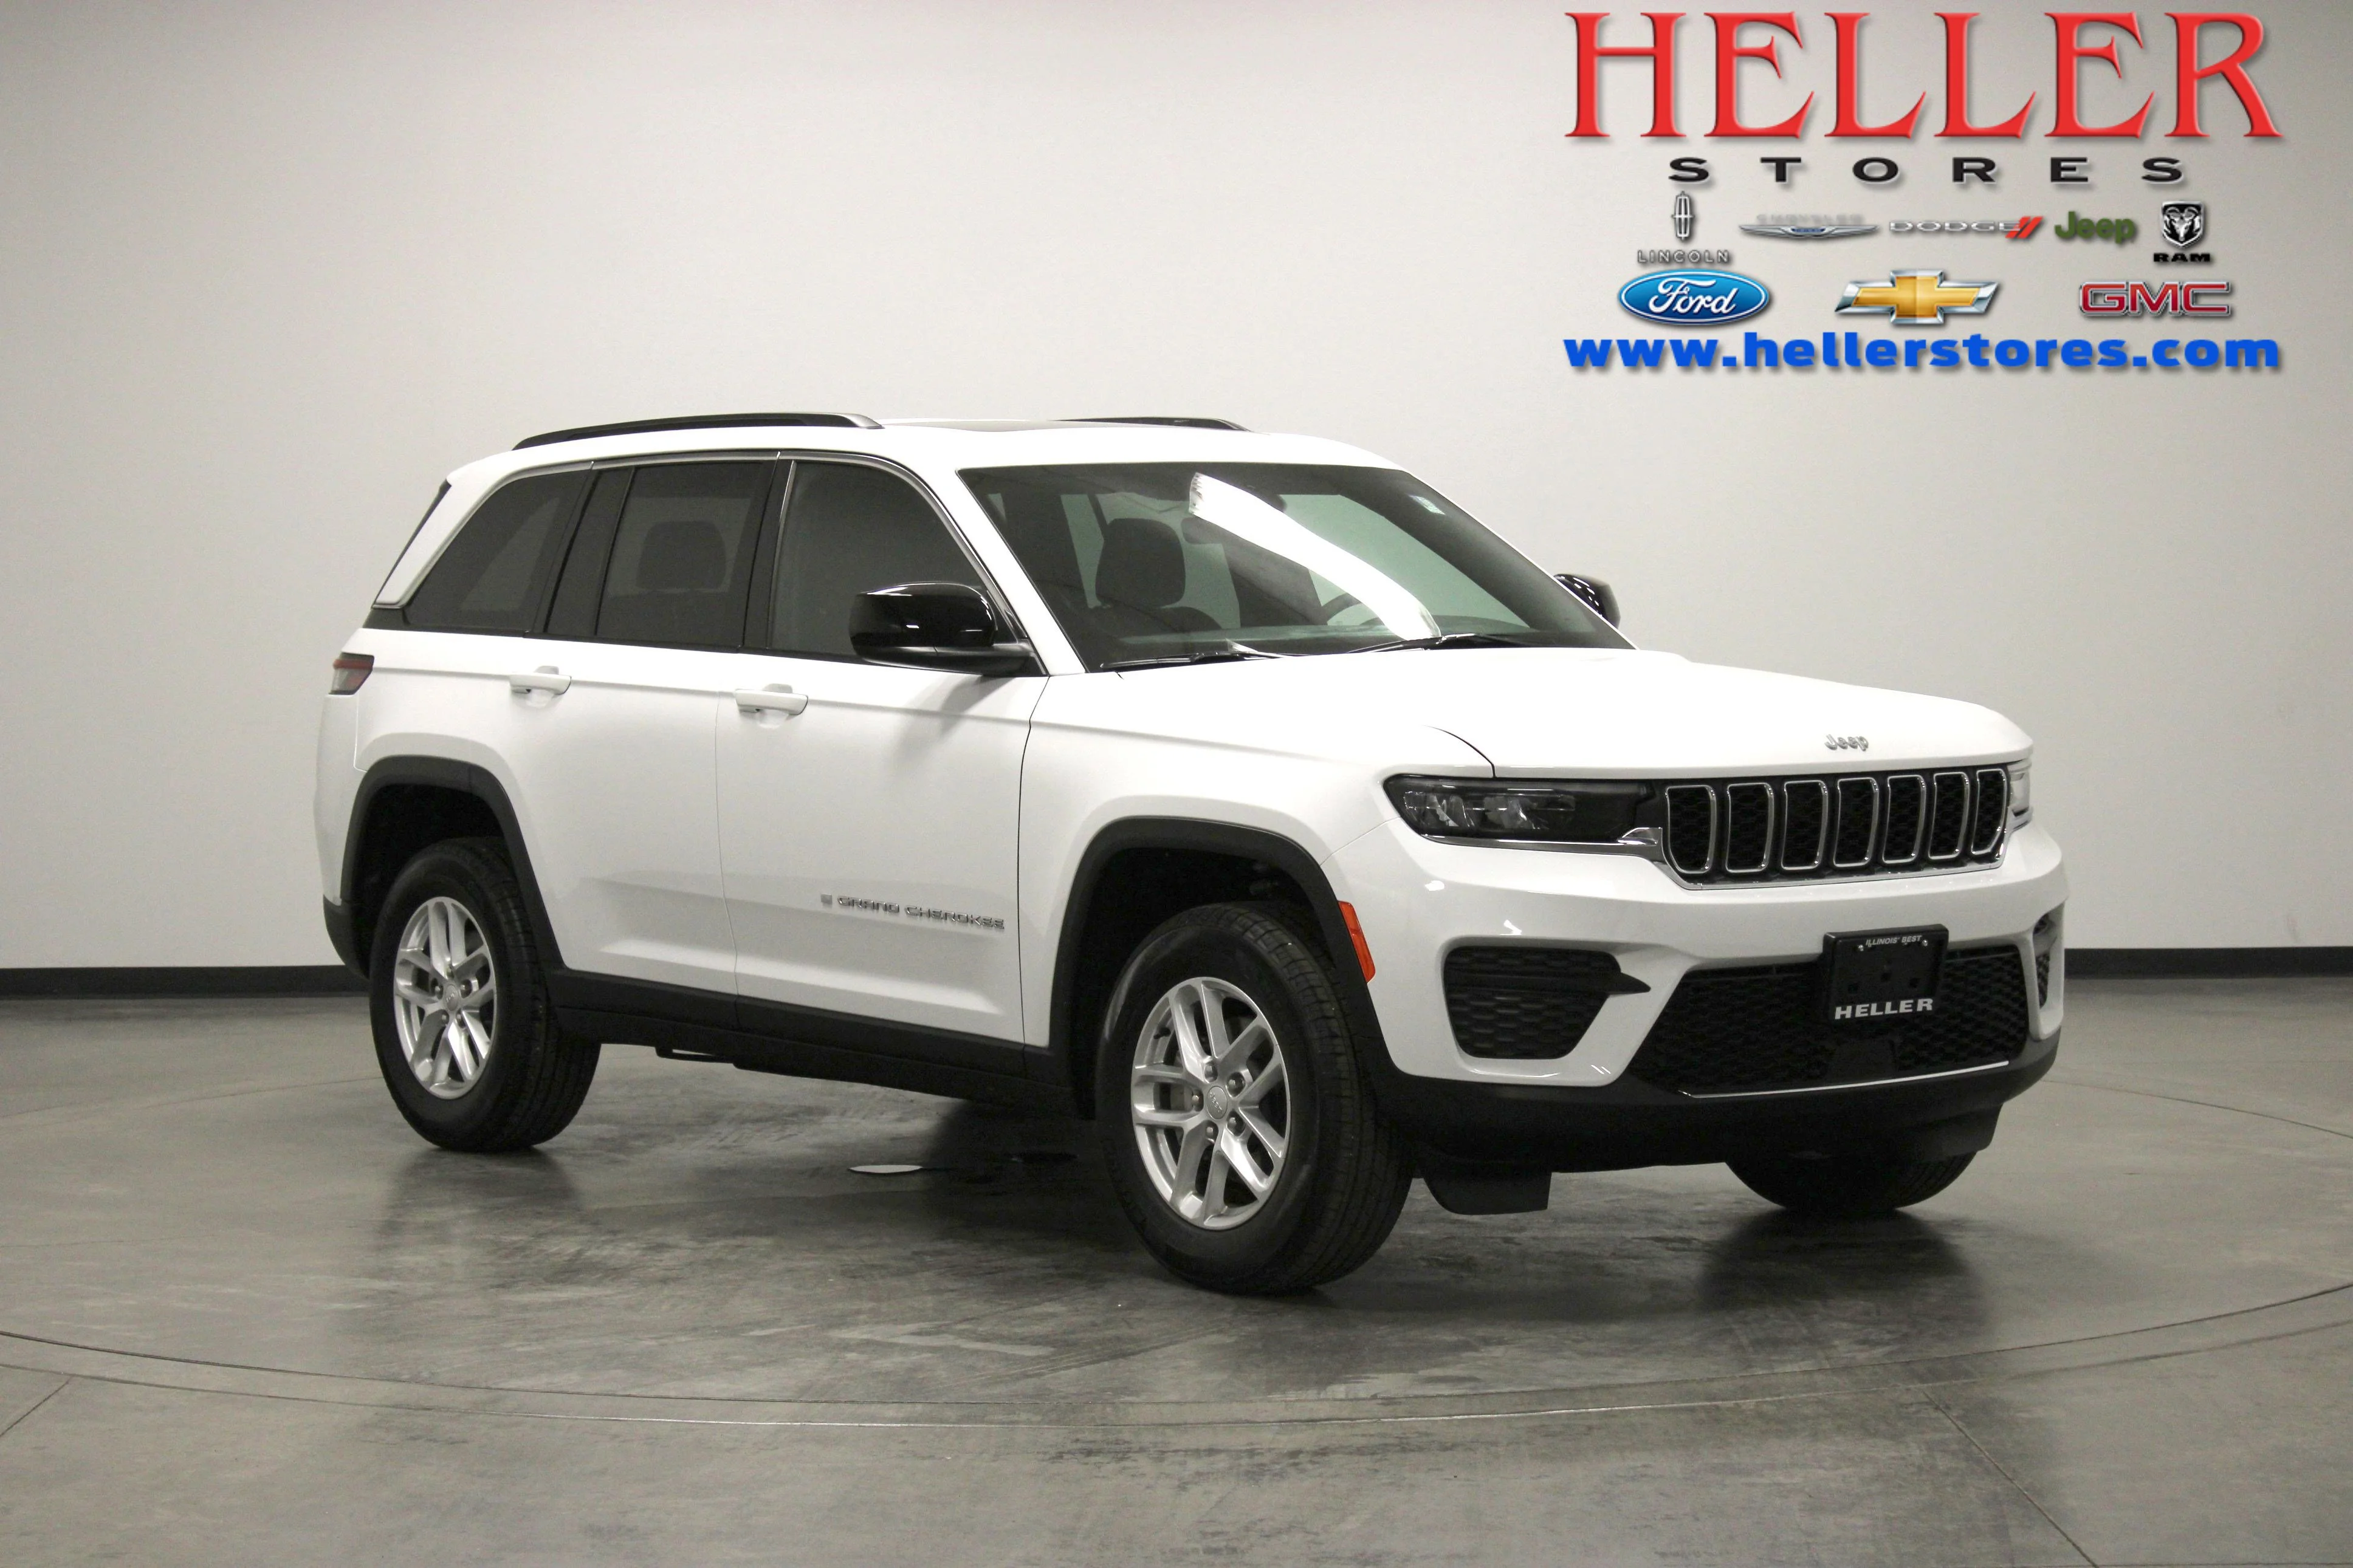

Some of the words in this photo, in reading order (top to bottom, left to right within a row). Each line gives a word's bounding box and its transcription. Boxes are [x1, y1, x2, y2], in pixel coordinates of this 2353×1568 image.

[1824, 734, 1869, 752] Jeep
[837, 895, 900, 913] GRAND
[904, 905, 1005, 930] CHEROKEE
[1835, 998, 1933, 1019] HELLER
